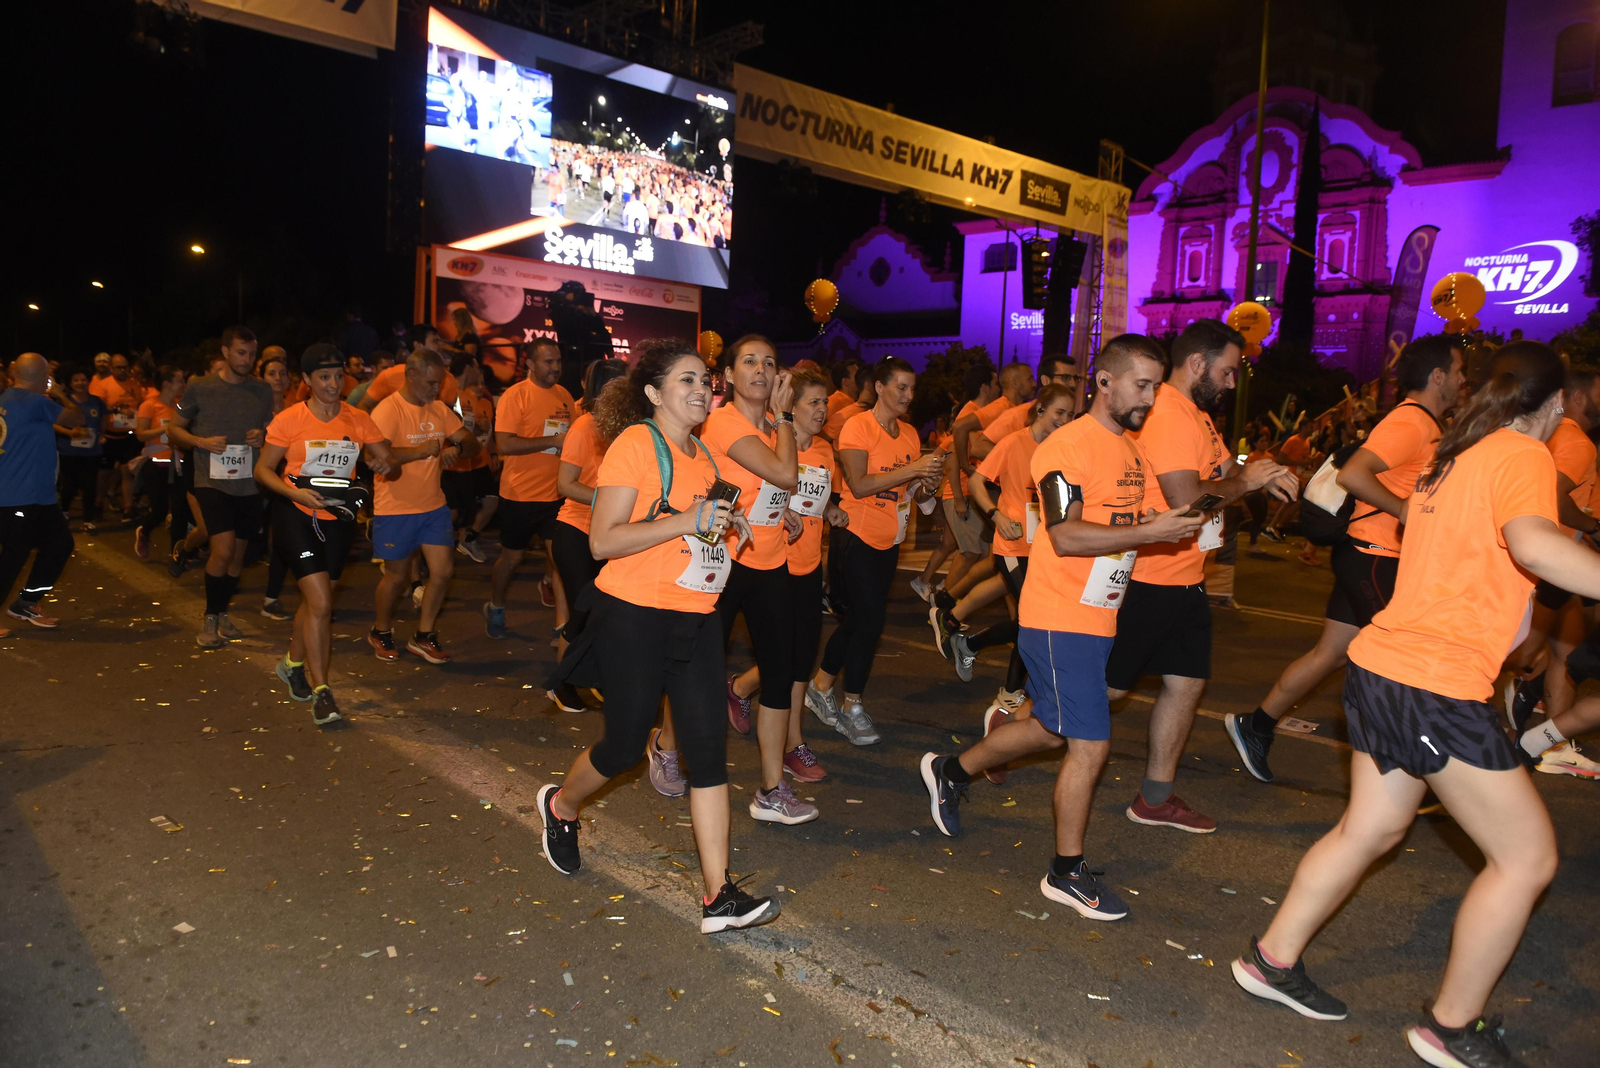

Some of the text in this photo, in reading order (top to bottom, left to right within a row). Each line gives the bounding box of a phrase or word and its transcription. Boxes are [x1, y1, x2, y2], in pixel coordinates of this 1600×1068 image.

[740, 92, 874, 155] NOCTURNA
[880, 134, 964, 181] SEVILLA
[1464, 253, 1529, 267] NOCTURNA
[1514, 303, 1569, 315] SEVILLA
[1010, 311, 1045, 326] Sevill
[220, 456, 246, 465] 17641
[318, 452, 349, 466] 11119
[797, 480, 826, 497] 11347
[701, 545, 725, 564] 11449
